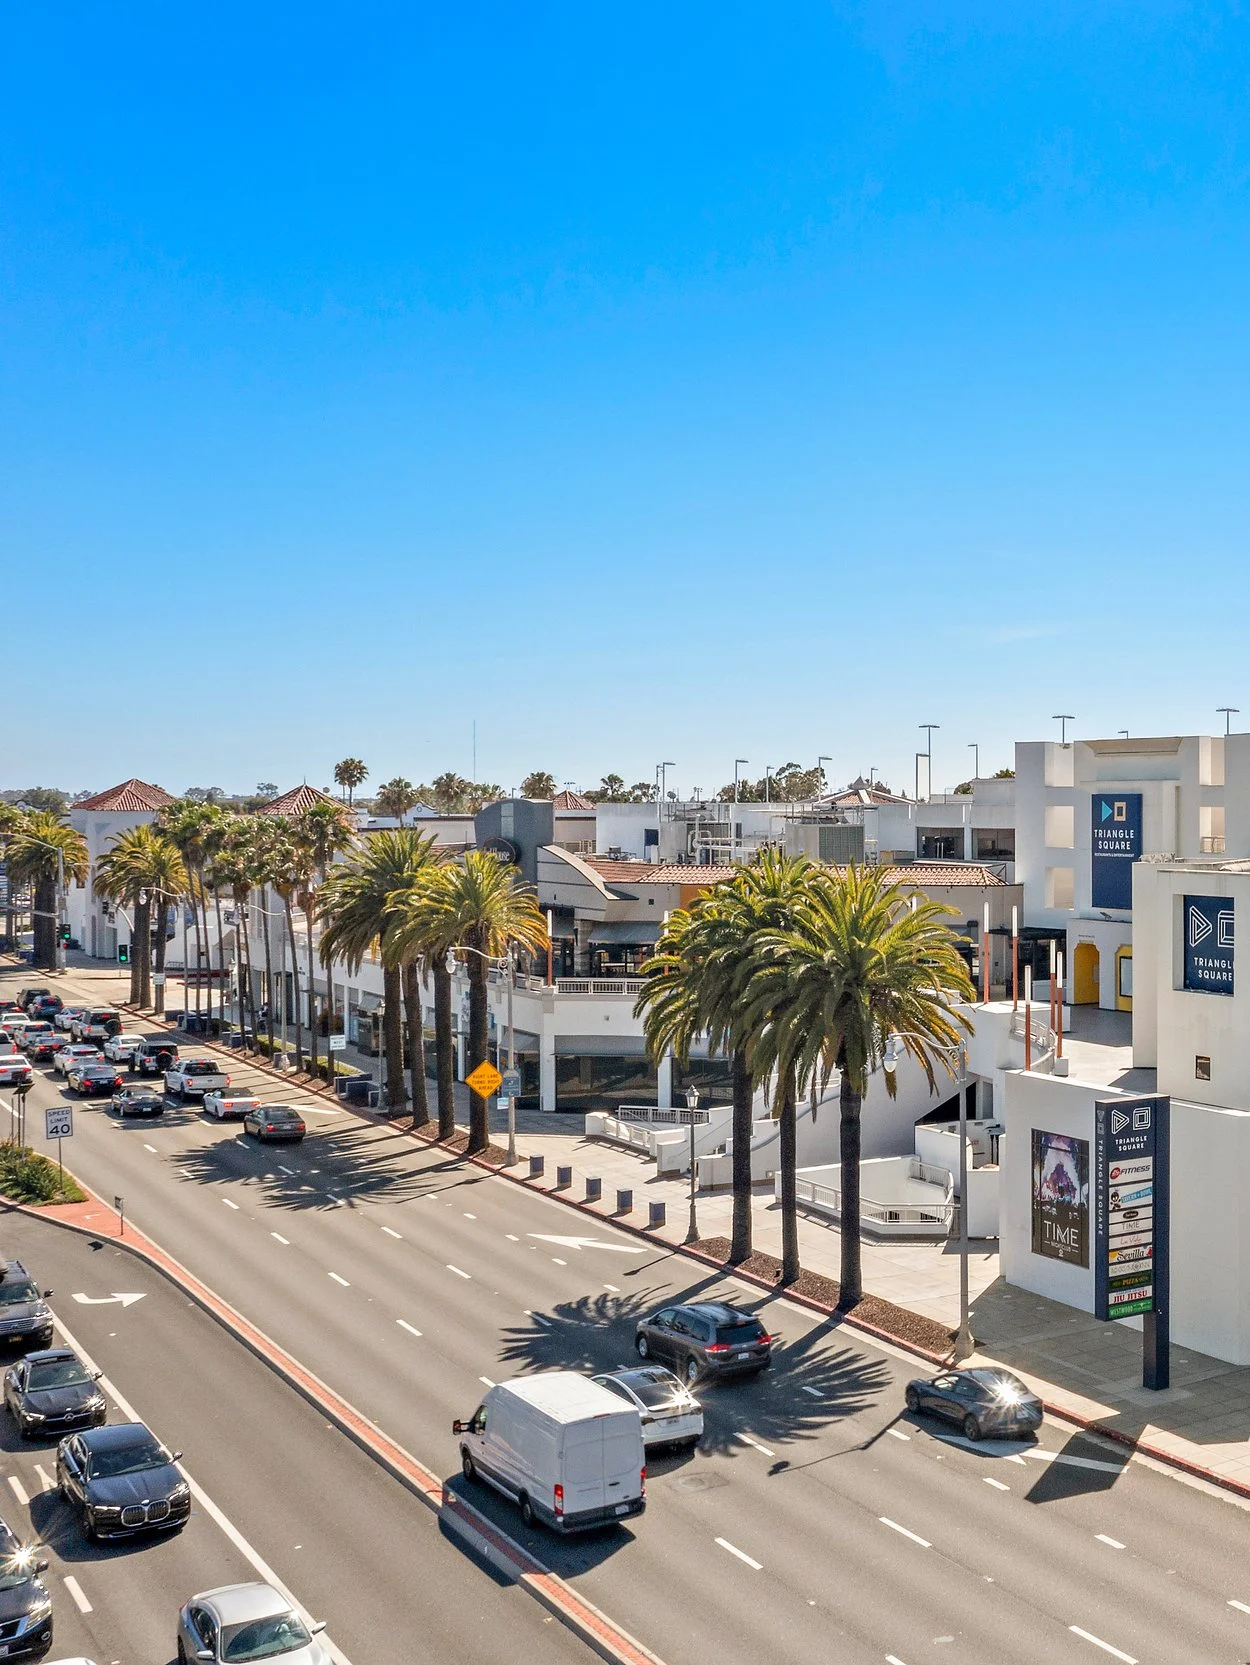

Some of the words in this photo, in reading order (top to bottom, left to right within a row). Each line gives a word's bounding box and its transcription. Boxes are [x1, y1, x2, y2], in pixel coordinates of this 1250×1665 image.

[1094, 829, 1135, 839] TRIANGLE
[1098, 840, 1131, 850] SQUARE
[1194, 957, 1235, 970] TRIANGL
[1198, 969, 1233, 982] SQUARE
[49, 1124, 70, 1134] 40
[1115, 1136, 1147, 1145] TRIANGLE
[1118, 1143, 1144, 1152] SQUARE
[1120, 1165, 1151, 1175] FITNESS
[1122, 1221, 1140, 1231] TIME
[1044, 1220, 1078, 1247] TIME
[1117, 1249, 1145, 1262] Sevilla
[1114, 1295, 1125, 1303] JIU
[1127, 1291, 1147, 1300] JITSU
